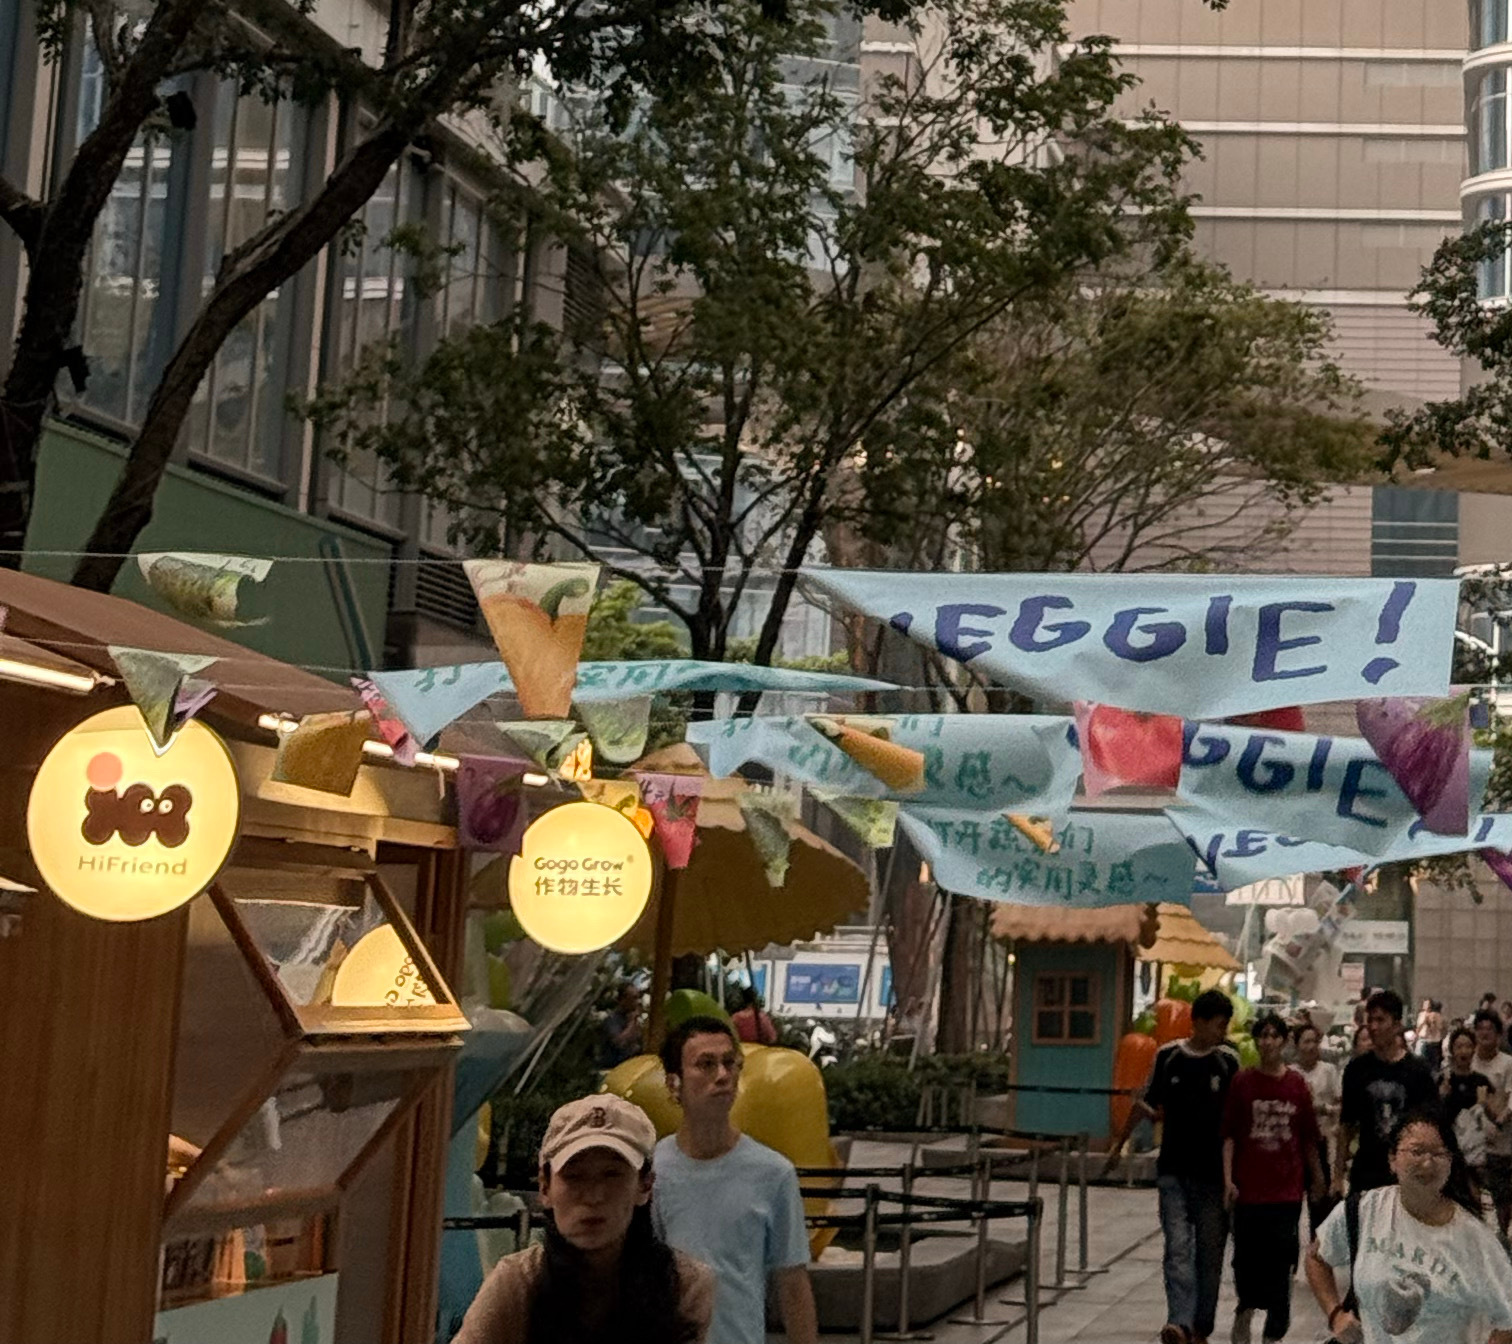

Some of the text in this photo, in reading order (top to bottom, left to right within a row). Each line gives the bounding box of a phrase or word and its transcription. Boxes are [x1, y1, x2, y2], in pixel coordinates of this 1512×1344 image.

[889, 580, 1417, 685] EGGIE!
[78, 855, 188, 876] HiFriend
[534, 857, 624, 874] Gogo Grow
[535, 876, 623, 896] 作物生长
